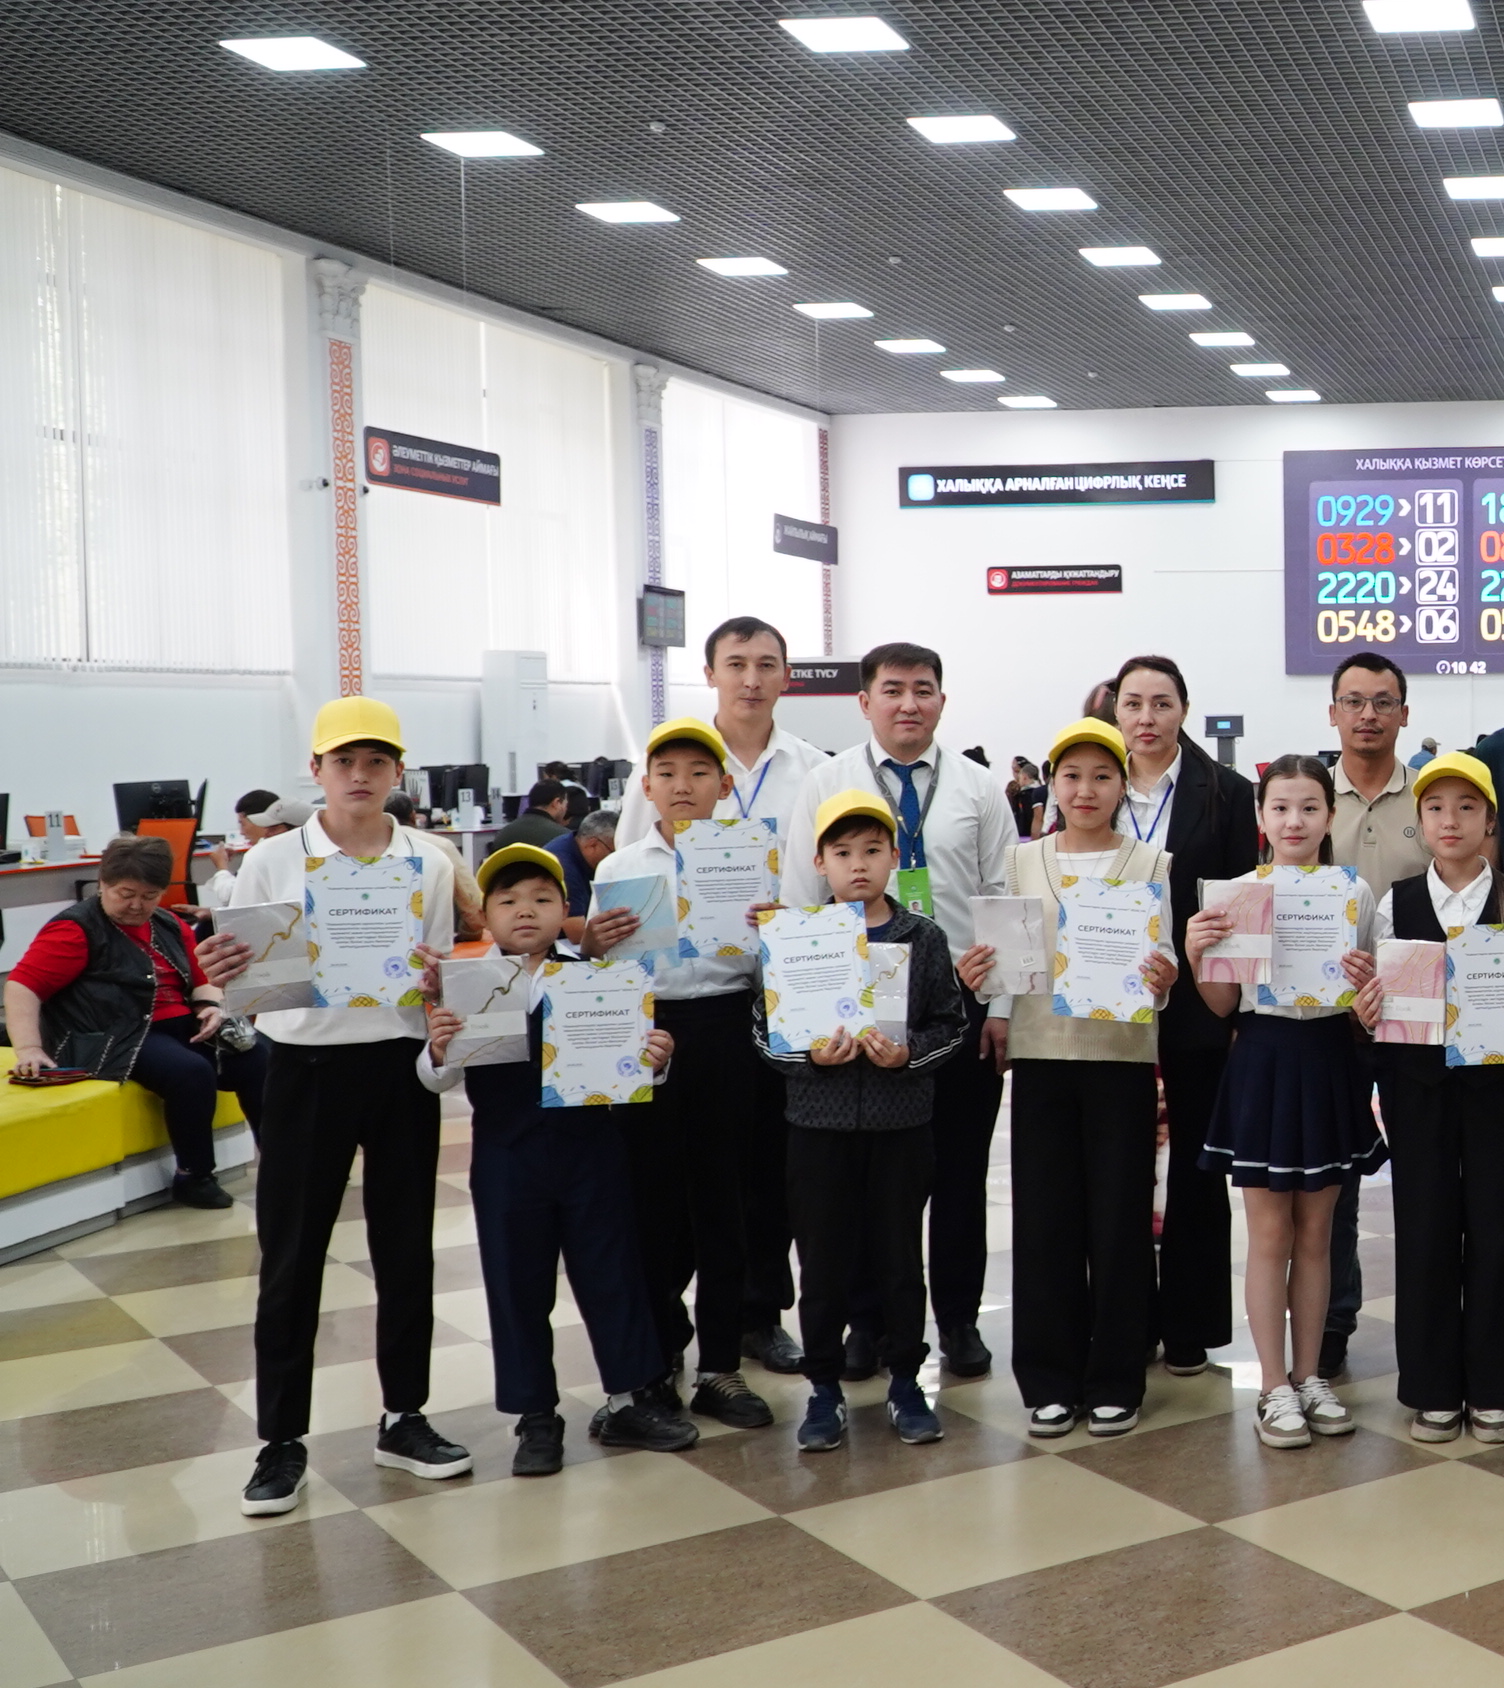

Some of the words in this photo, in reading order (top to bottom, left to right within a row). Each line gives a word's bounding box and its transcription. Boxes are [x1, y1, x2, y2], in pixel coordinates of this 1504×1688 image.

[1356, 458, 1412, 470] ХАЛЫҚҚА
[1415, 457, 1462, 470] ҚЫЗМЕТ
[937, 479, 1004, 494] ХАЛЫҚҚА
[1005, 477, 1075, 492] АРНАЛҒАН
[1076, 475, 1142, 491] ЦИФРЛЫҚ
[1144, 474, 1186, 490] КЕҢСЕ
[1317, 494, 1395, 527] 0929
[1419, 492, 1452, 524] 11
[1316, 532, 1396, 565] 0328
[1418, 532, 1455, 562] 02
[1011, 570, 1062, 579] АЗАМАТТАРДЫ
[1317, 571, 1396, 604] 2220
[1419, 570, 1456, 602] 24
[1317, 609, 1396, 643] 0548
[1419, 608, 1457, 640] 06
[791, 669, 814, 679] ЕТКЕ
[1452, 662, 1467, 674] 10
[1469, 662, 1486, 674] 42
[461, 791, 471, 802] 13
[48, 814, 62, 827] 11
[696, 865, 756, 874] СЕРТИФИКАТ
[328, 908, 398, 916] СЕРТИФИКАТ
[1077, 925, 1136, 935] СЕРТИФИКАТ
[783, 952, 845, 964] СЕРТИФИКАТ
[565, 1009, 630, 1019] СЕРТИФИКАТ
